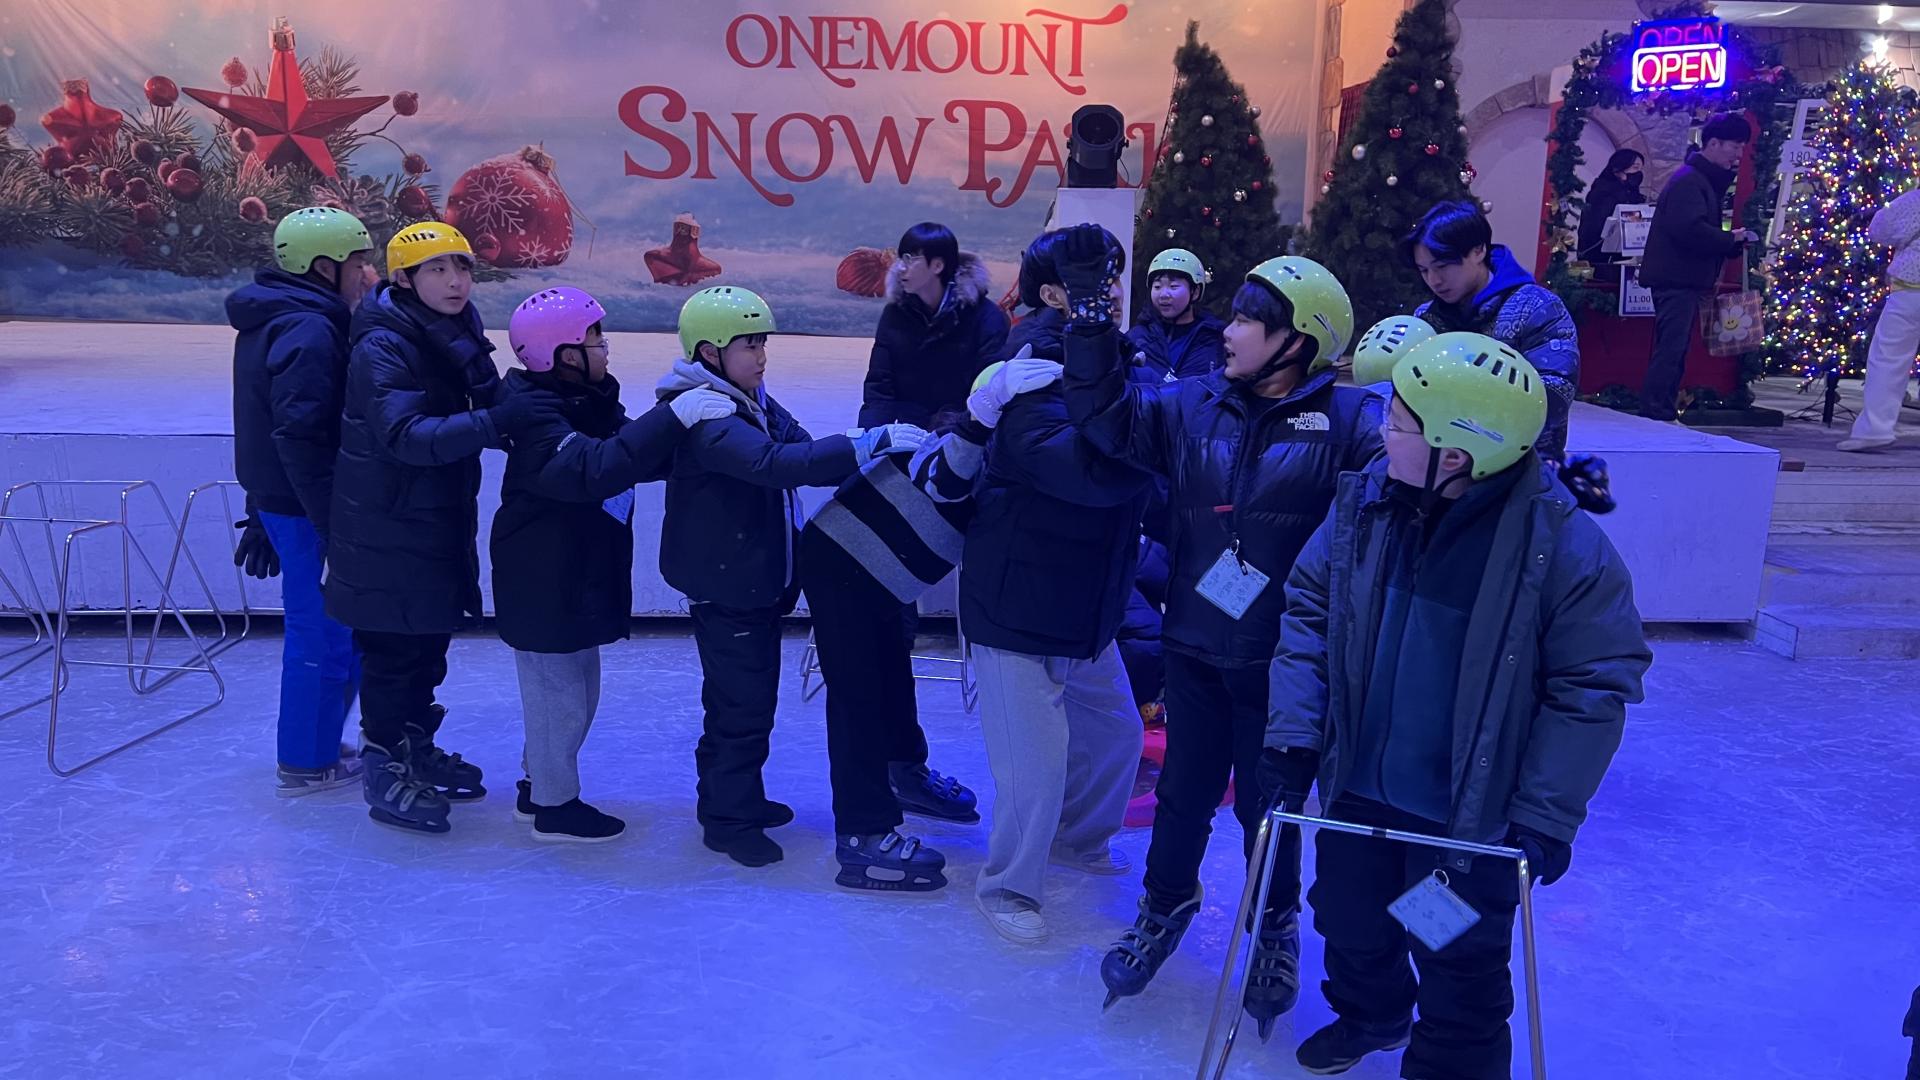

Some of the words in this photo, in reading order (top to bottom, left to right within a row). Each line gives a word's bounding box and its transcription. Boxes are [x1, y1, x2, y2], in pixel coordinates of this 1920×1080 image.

[725, 3, 1128, 95] ONEMOUNT
[1637, 51, 1721, 84] OPEN
[617, 85, 935, 208] SNOW
